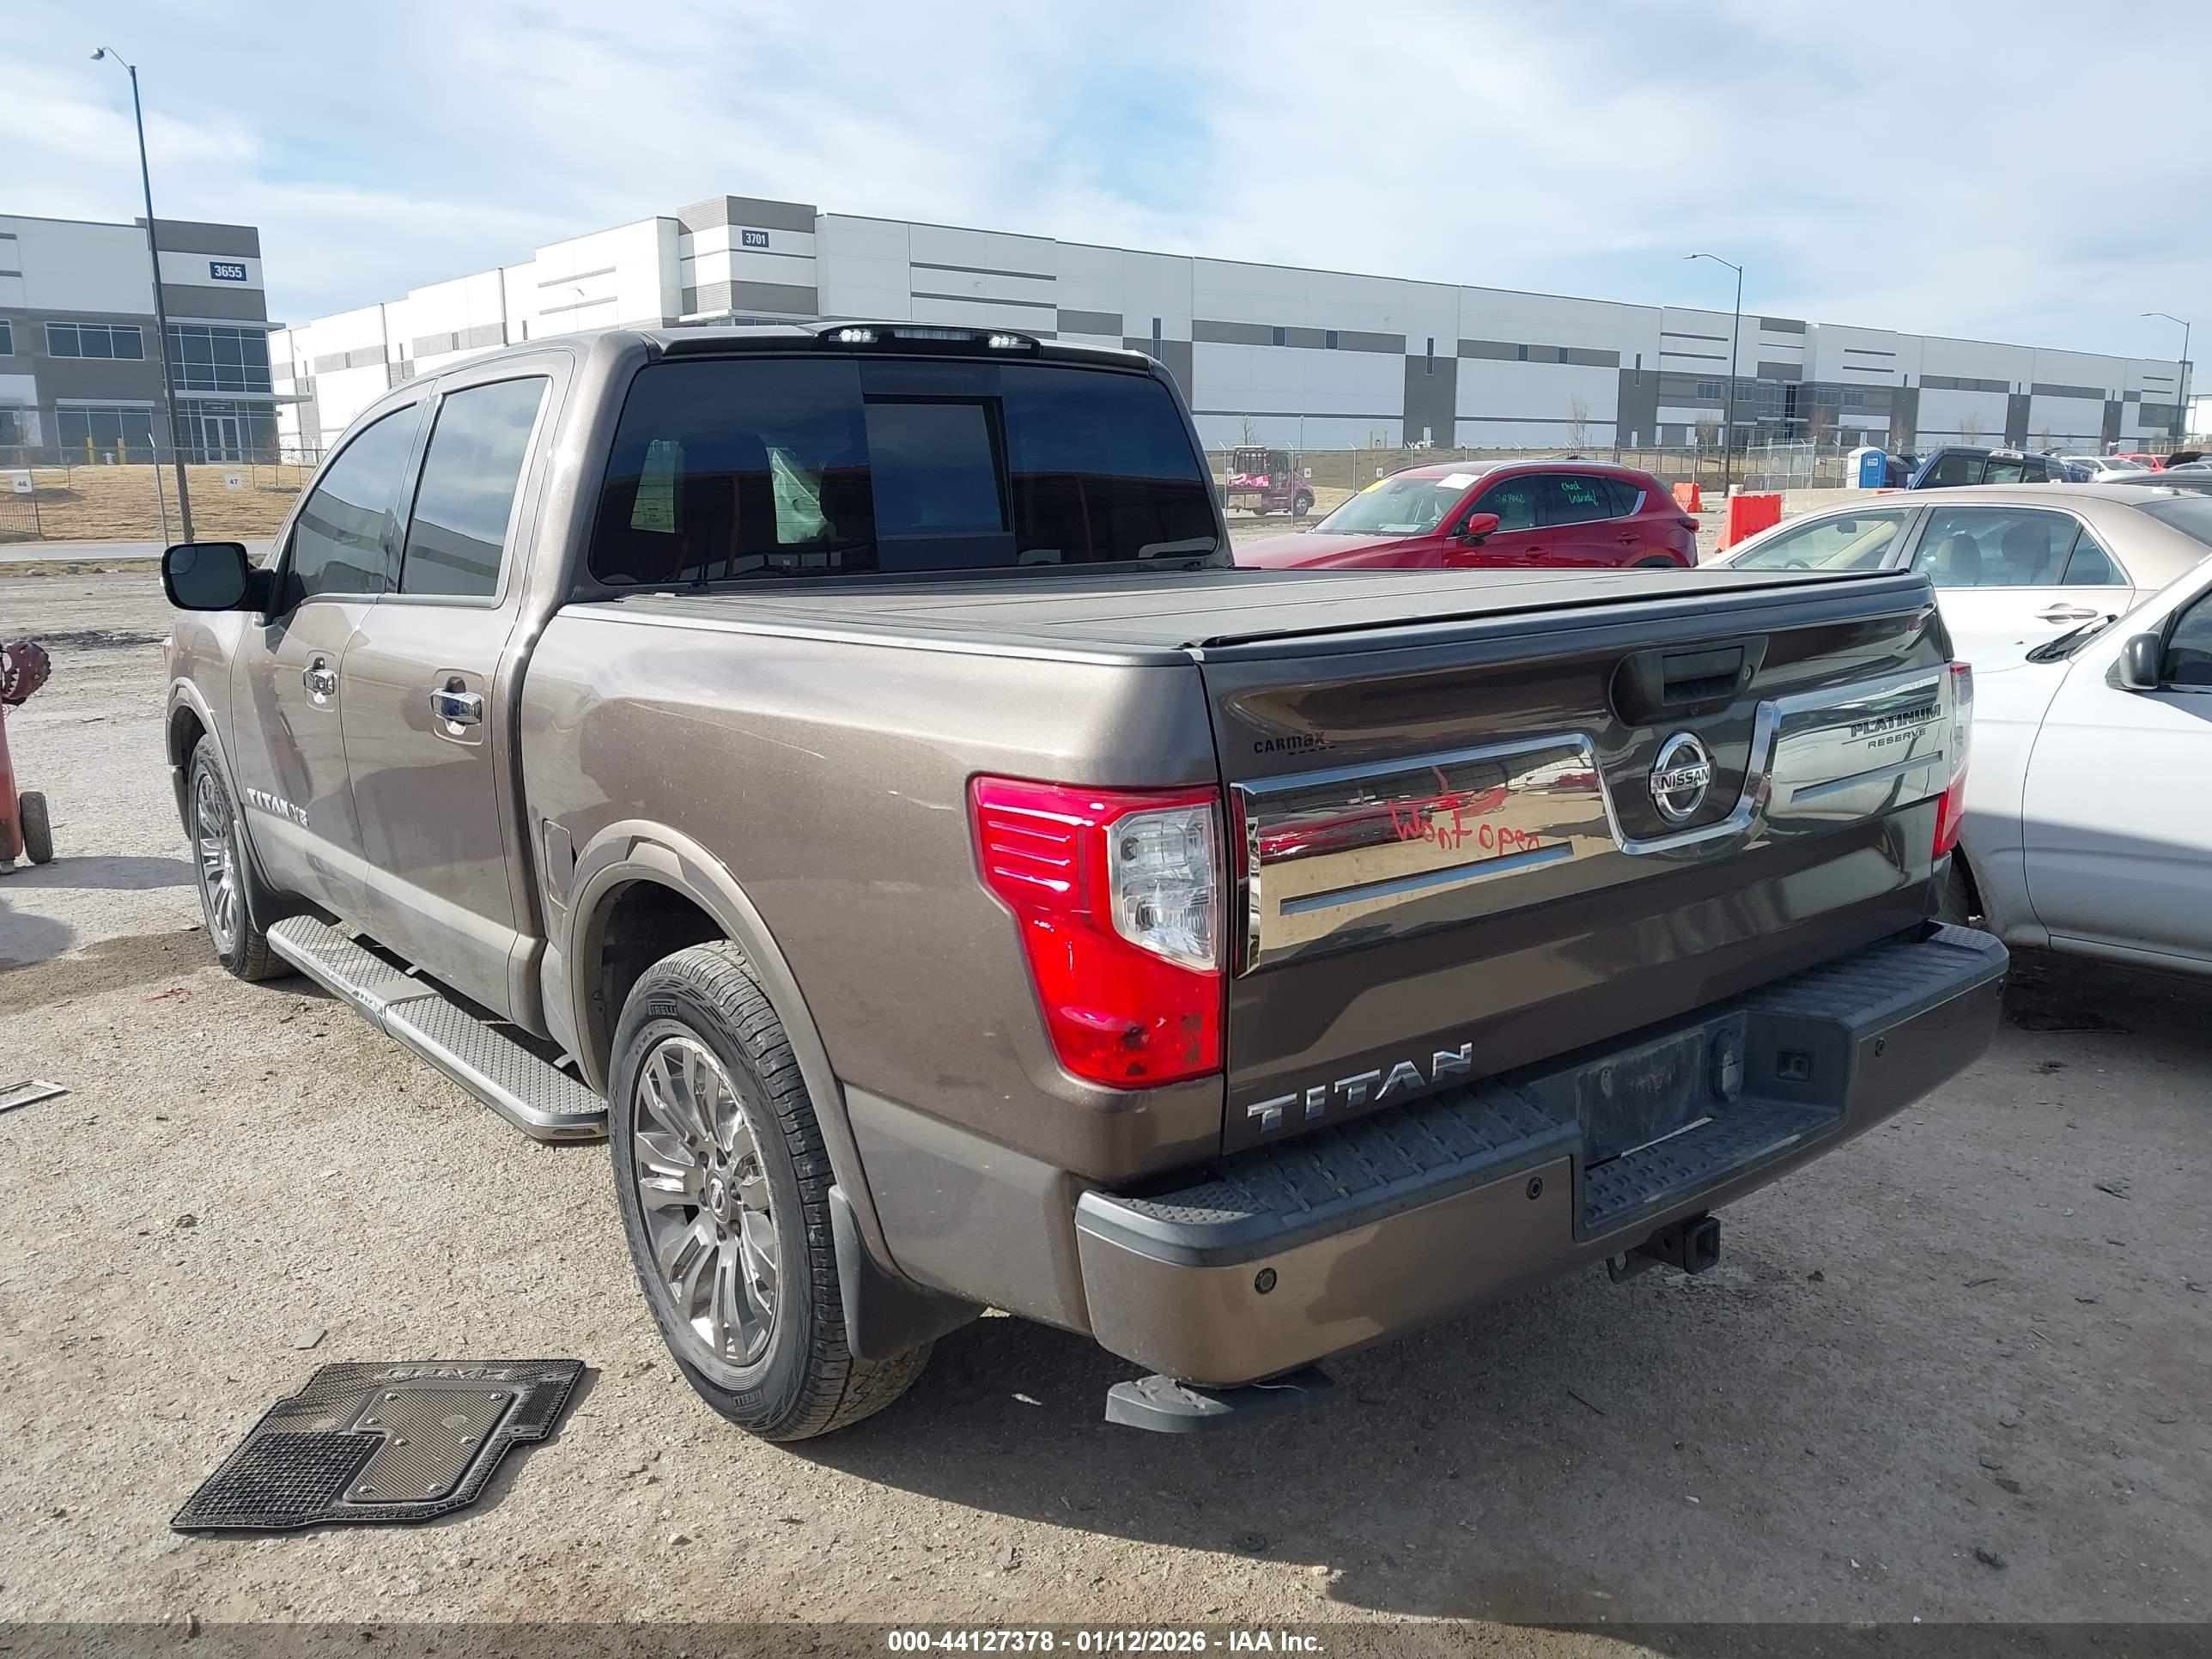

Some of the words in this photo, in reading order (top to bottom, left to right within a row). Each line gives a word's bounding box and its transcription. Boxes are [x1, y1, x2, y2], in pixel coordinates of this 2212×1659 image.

[746, 233, 766, 246] 3701
[214, 264, 242, 278] 3655
[1850, 704, 1942, 738] PLATINUM
[1868, 727, 1926, 749] RESERVE
[1661, 768, 1710, 789] NISSAN
[247, 787, 291, 817] TITAN
[1248, 1042, 1473, 1133] TITAN
